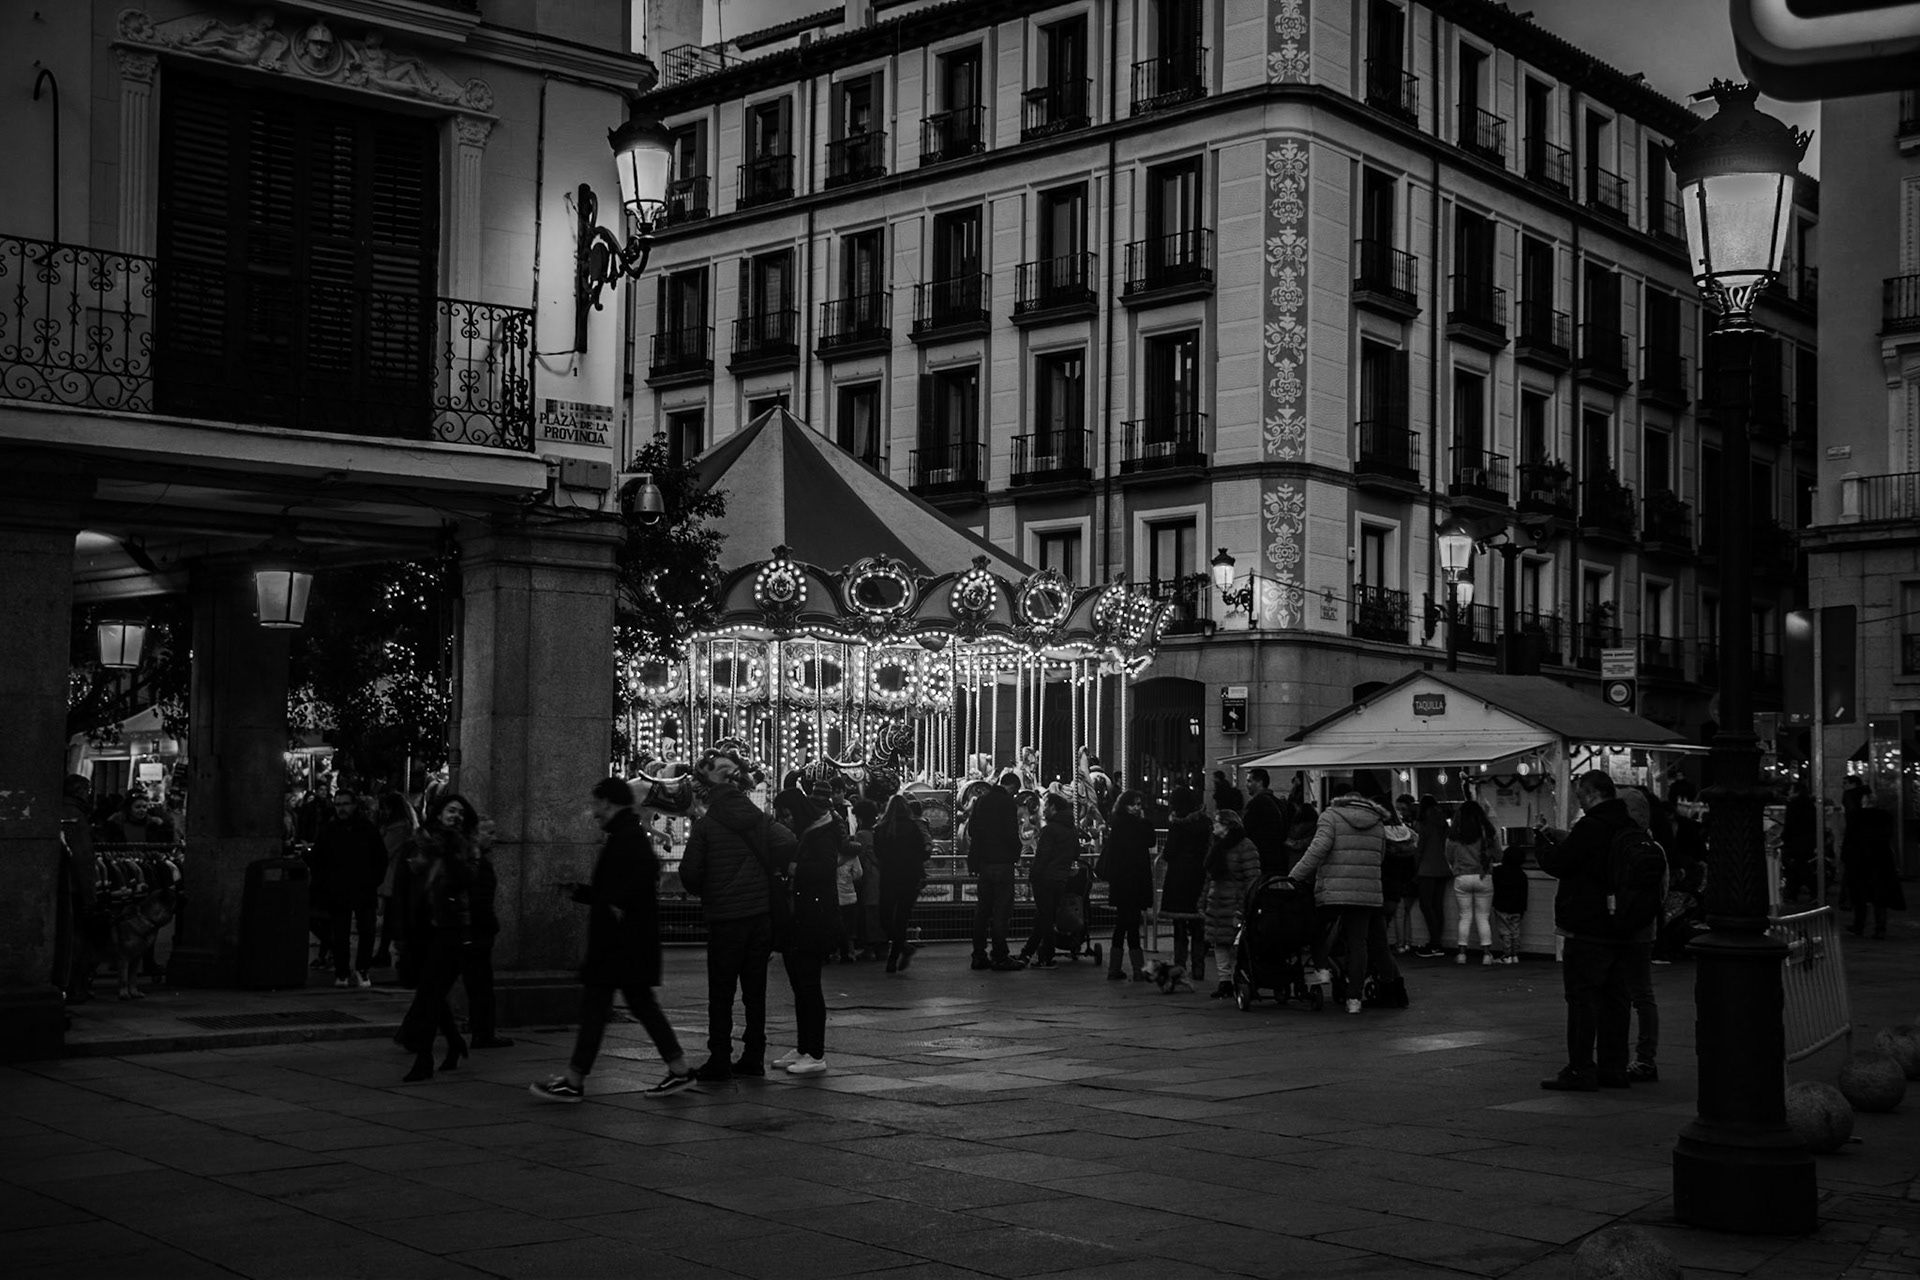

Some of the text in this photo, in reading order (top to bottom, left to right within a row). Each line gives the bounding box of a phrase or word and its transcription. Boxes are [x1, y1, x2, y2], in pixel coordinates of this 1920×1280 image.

[572, 366, 578, 377] 1
[539, 412, 609, 432] PLAZA DE LA
[544, 425, 605, 445] PROVINCIA
[1415, 700, 1444, 711] TAQUILLA
